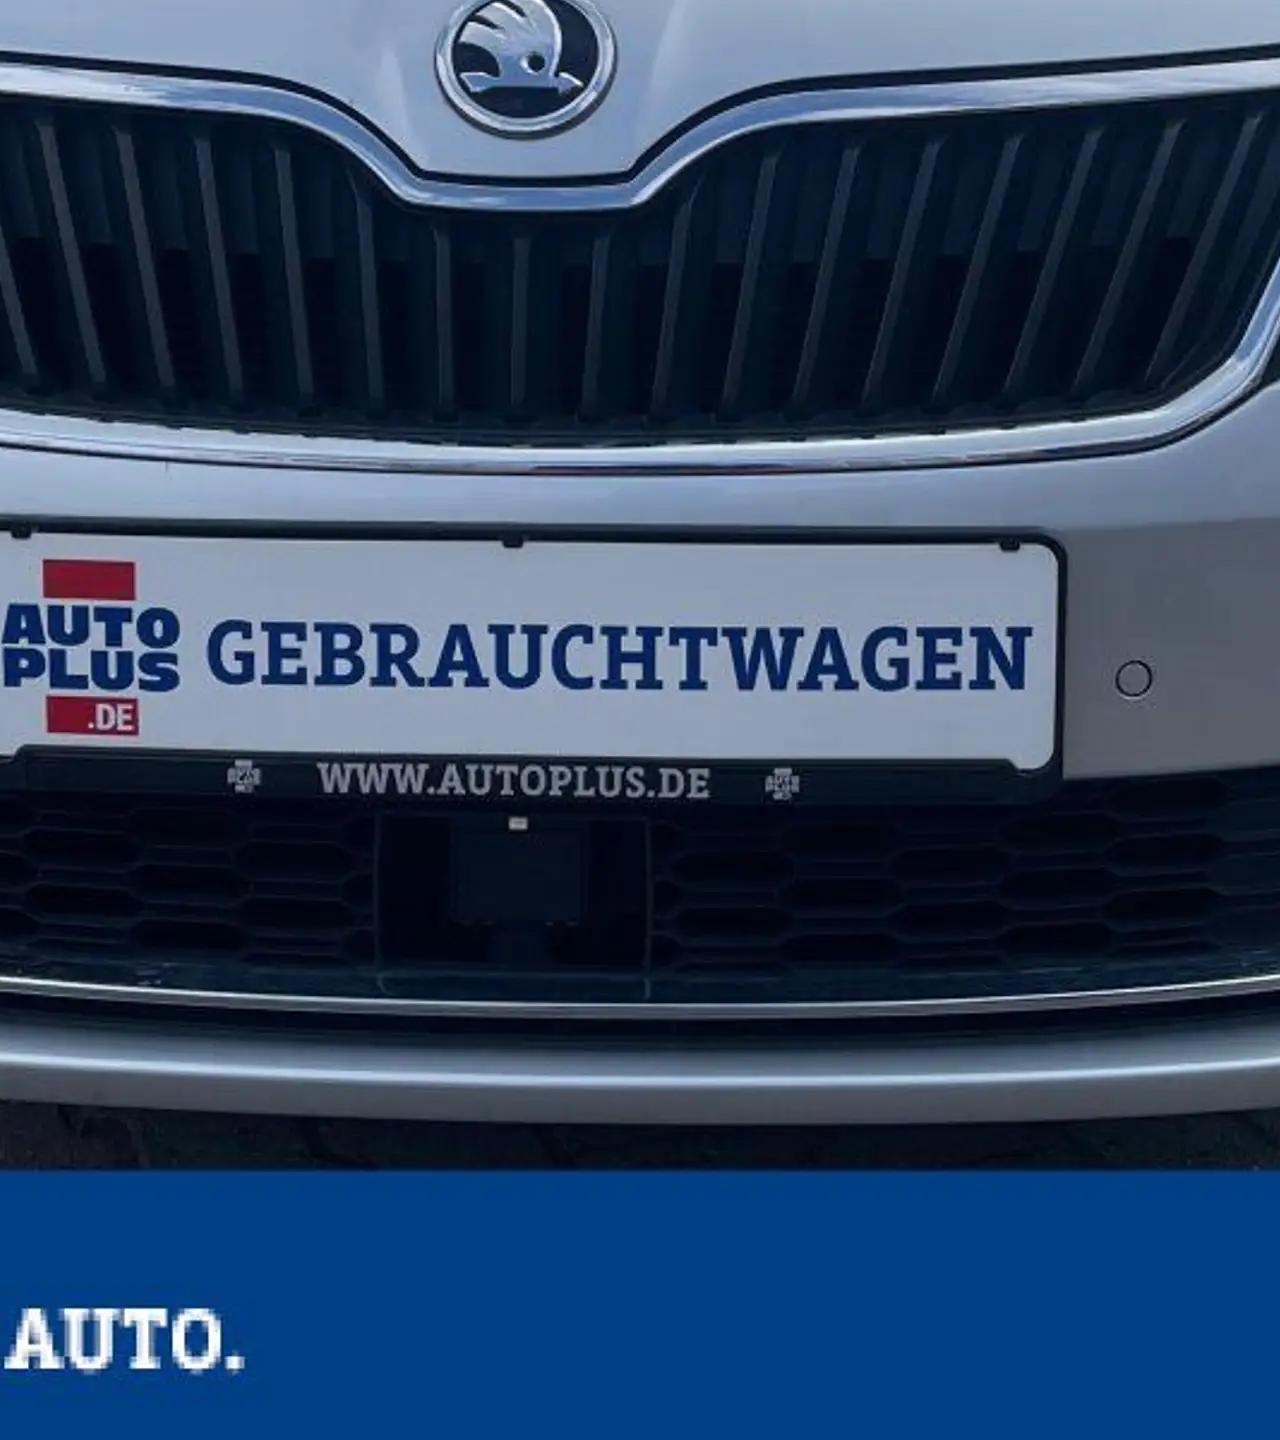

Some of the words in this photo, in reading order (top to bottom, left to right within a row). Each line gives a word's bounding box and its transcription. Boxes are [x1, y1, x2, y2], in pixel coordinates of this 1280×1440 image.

[1, 603, 181, 649] AUTO
[2, 647, 181, 693] PLUS
[205, 619, 1035, 694] GEBRAUCHTWAGEN
[87, 703, 134, 731] .DE
[317, 762, 711, 799] WWW.AUTOPLUS.DE
